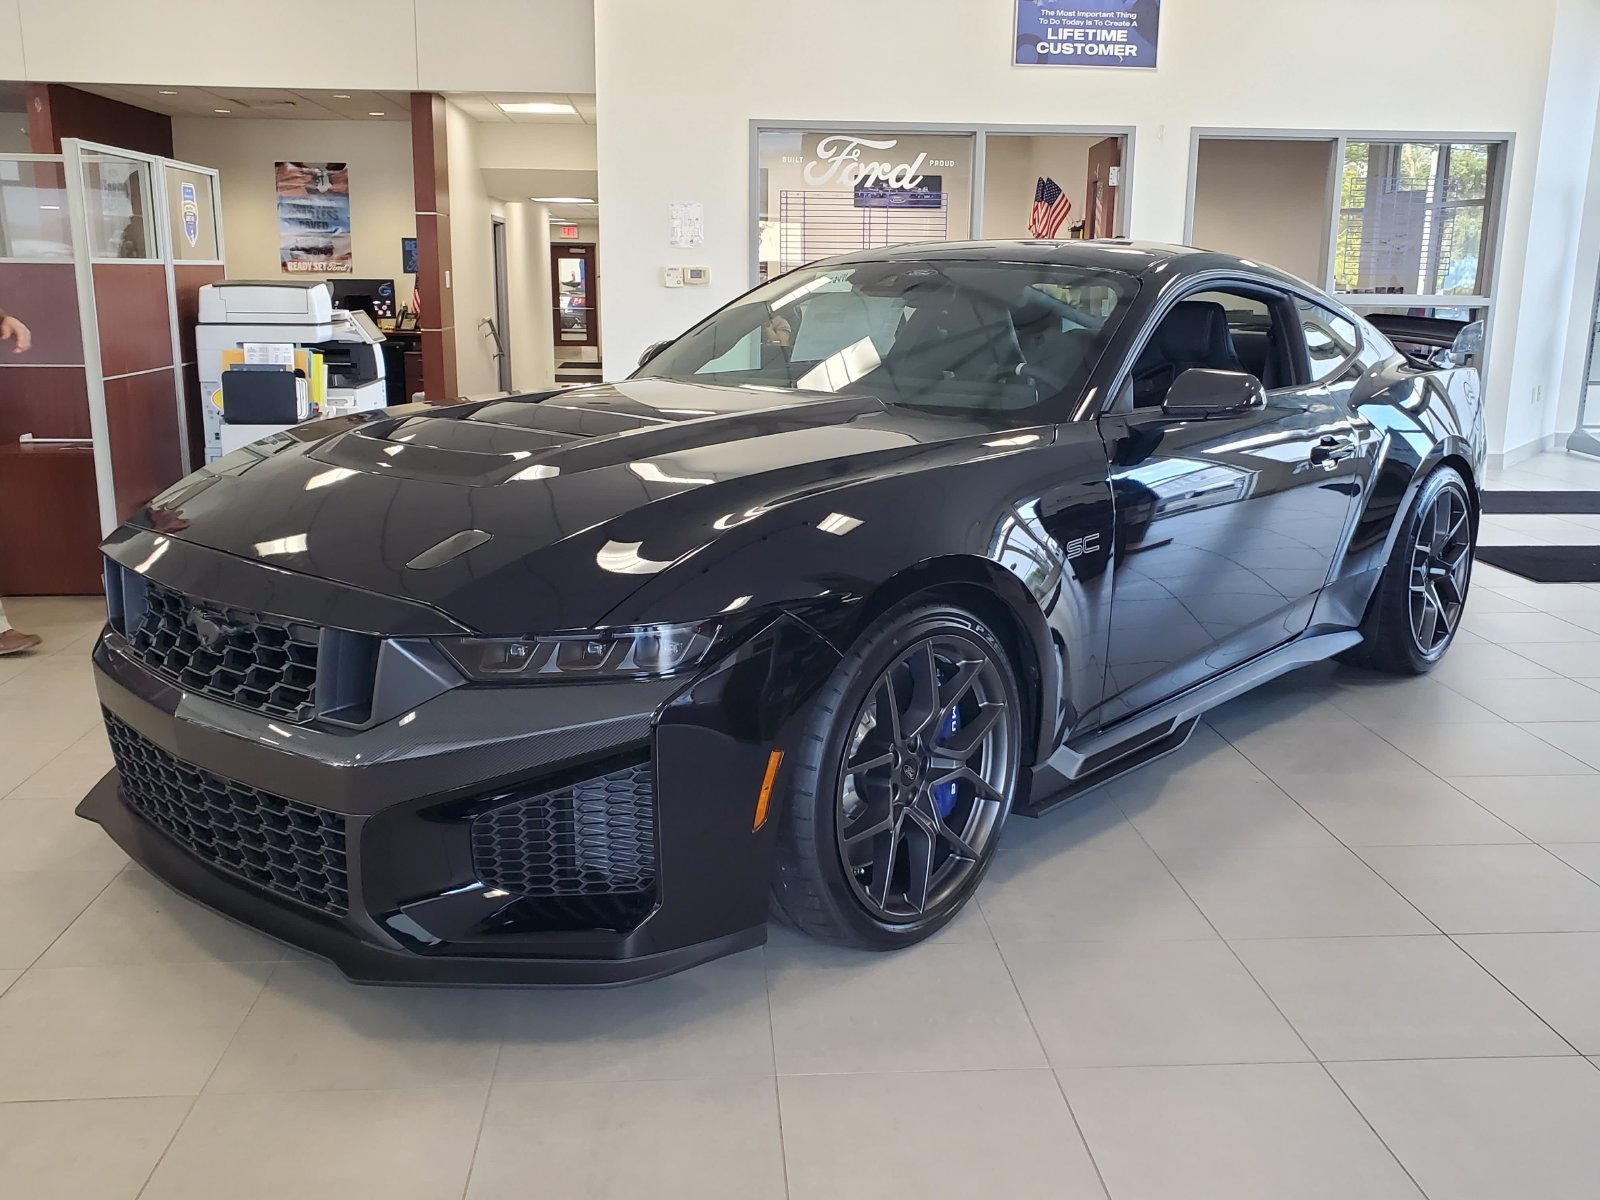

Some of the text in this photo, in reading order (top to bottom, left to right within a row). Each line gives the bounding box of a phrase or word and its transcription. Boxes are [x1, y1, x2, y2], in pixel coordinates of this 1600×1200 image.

[1077, 11, 1114, 19] Important
[1116, 12, 1137, 20] Thing
[1062, 19, 1084, 27] Today
[1047, 28, 1128, 42] LIFETIME
[1036, 42, 1138, 57] CUSTOMER
[782, 156, 804, 164] BUILT
[803, 135, 927, 190] Ford
[929, 159, 955, 168] PROUD
[287, 261, 312, 271] READY
[313, 261, 327, 271] SET
[1066, 532, 1100, 560] SC
